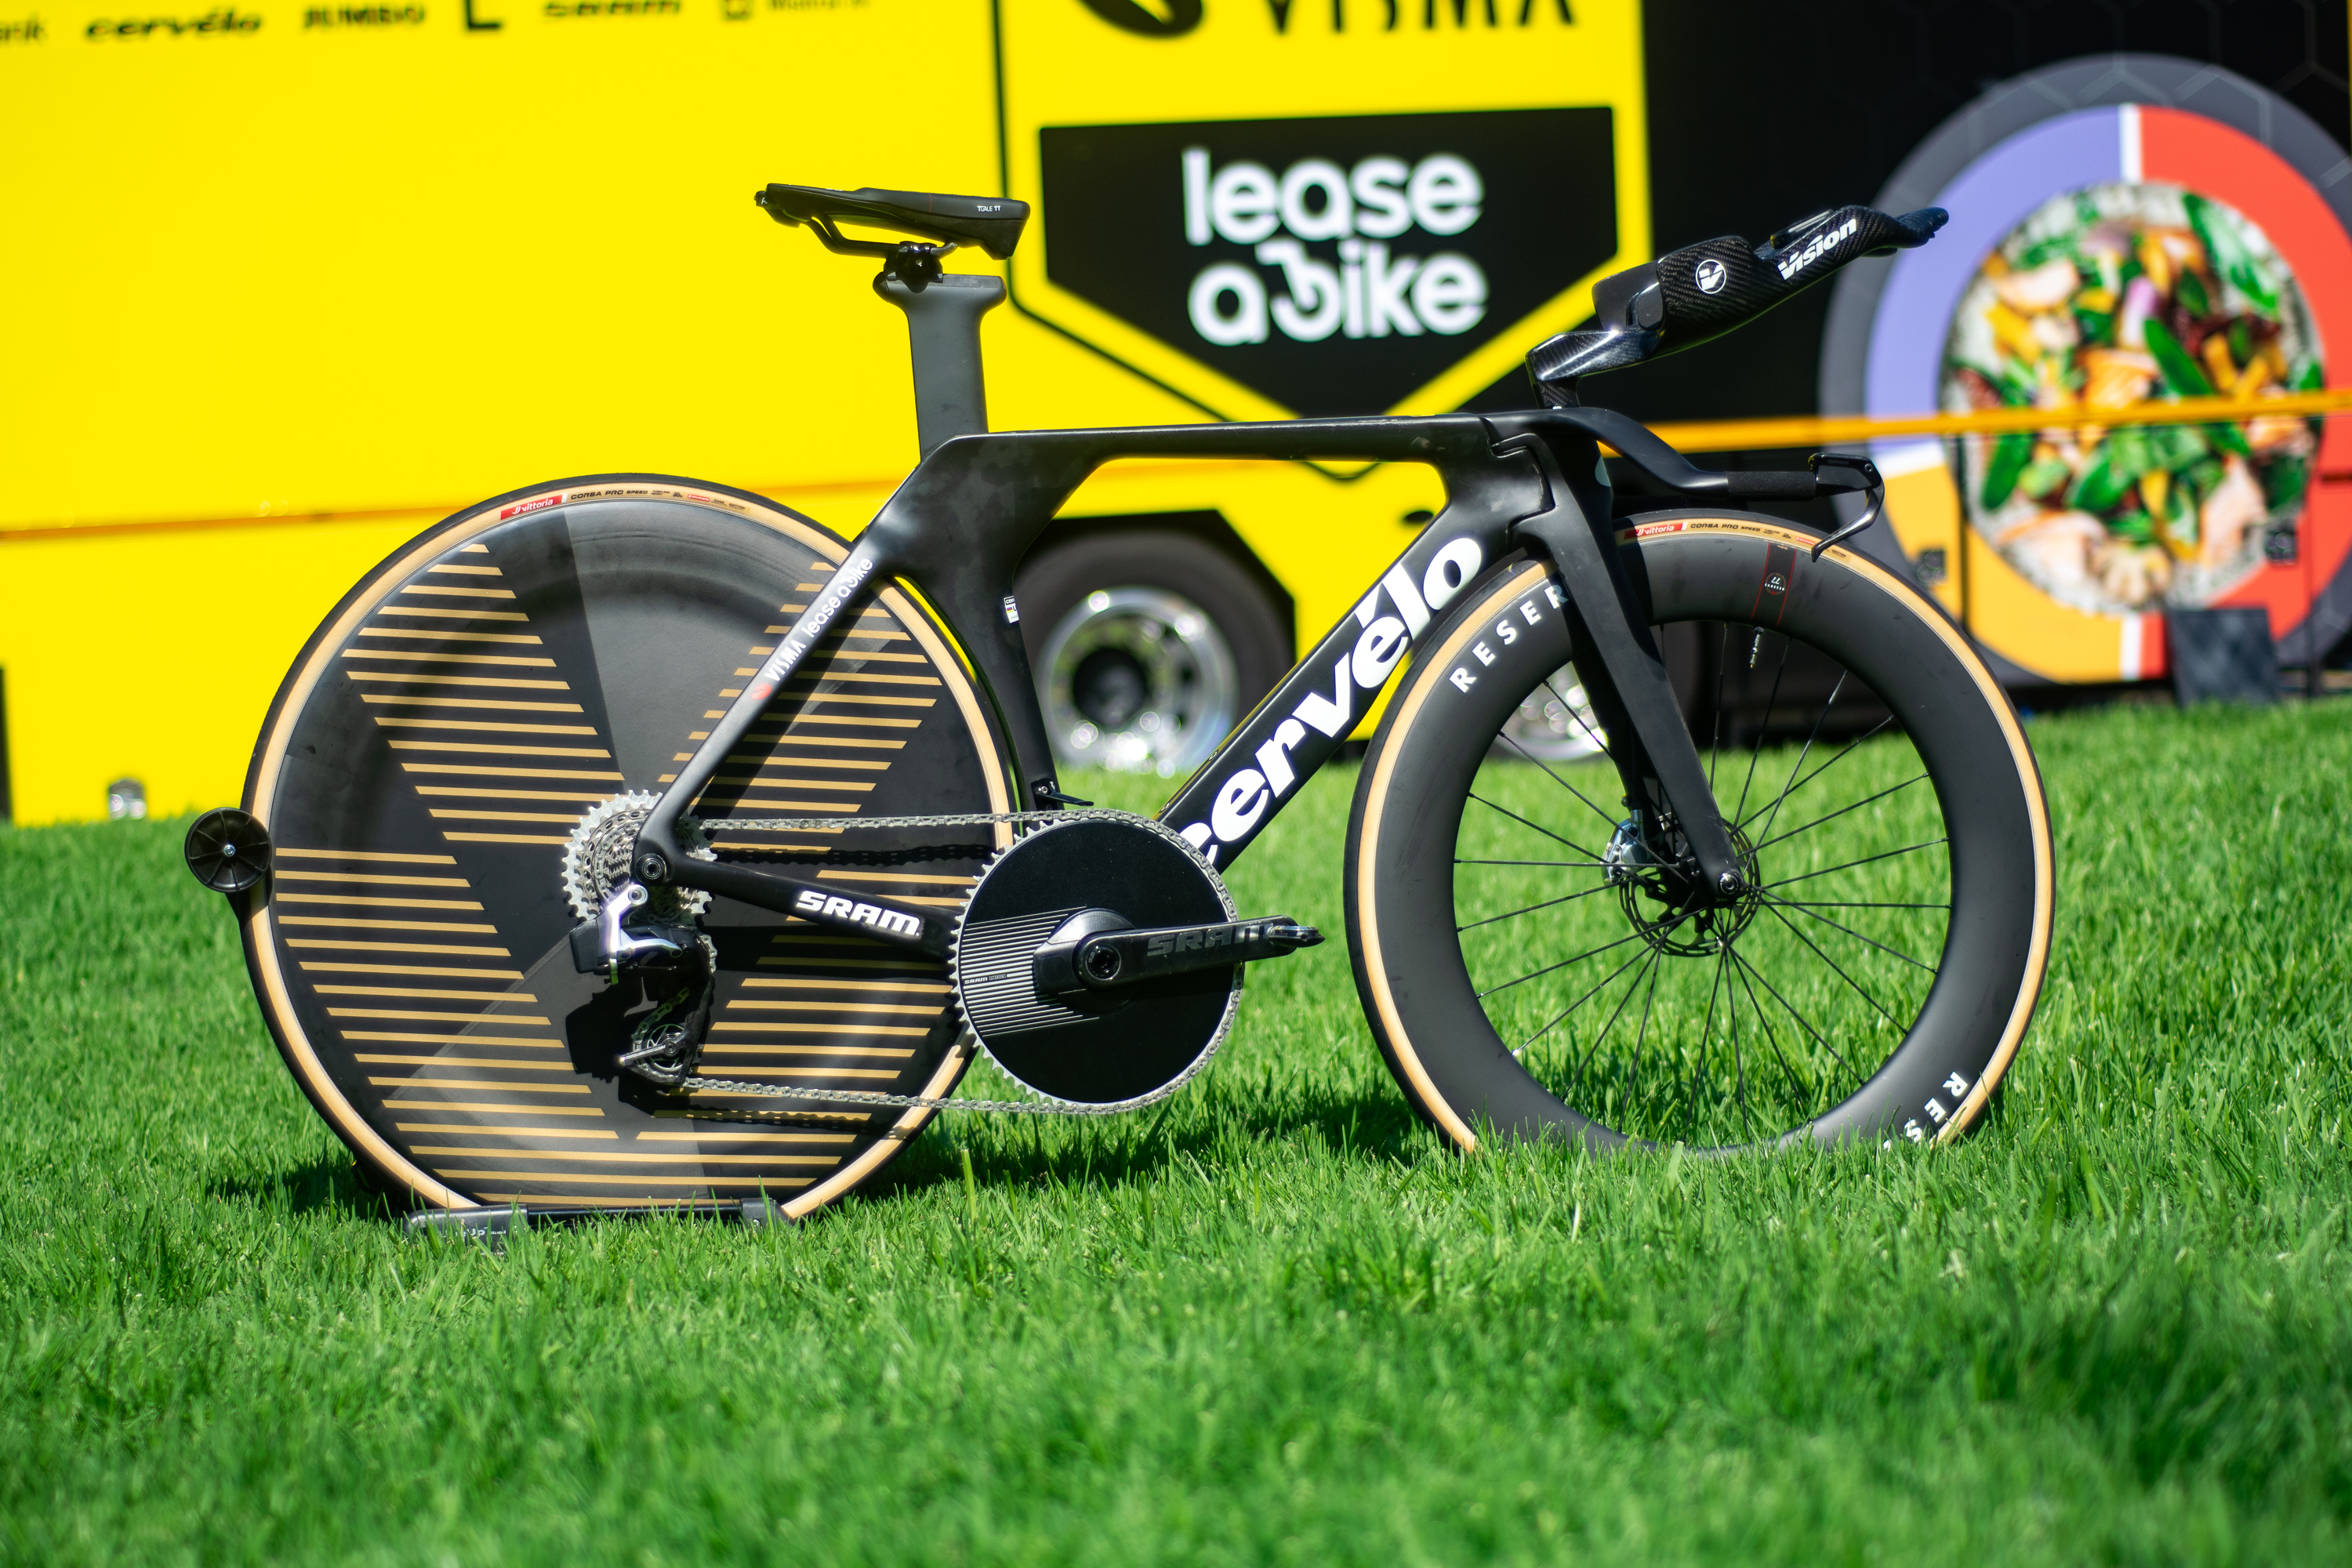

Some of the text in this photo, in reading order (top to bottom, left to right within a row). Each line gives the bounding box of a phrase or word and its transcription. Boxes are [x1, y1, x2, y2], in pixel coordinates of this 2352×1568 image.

[1181, 146, 1483, 245] lease
[521, 498, 554, 512] vittoria
[1644, 524, 1675, 535] vittoria
[764, 640, 807, 681] VISMA
[801, 597, 841, 637] lease
[796, 890, 920, 936] SRAM
[1147, 920, 1273, 956] SRAM
